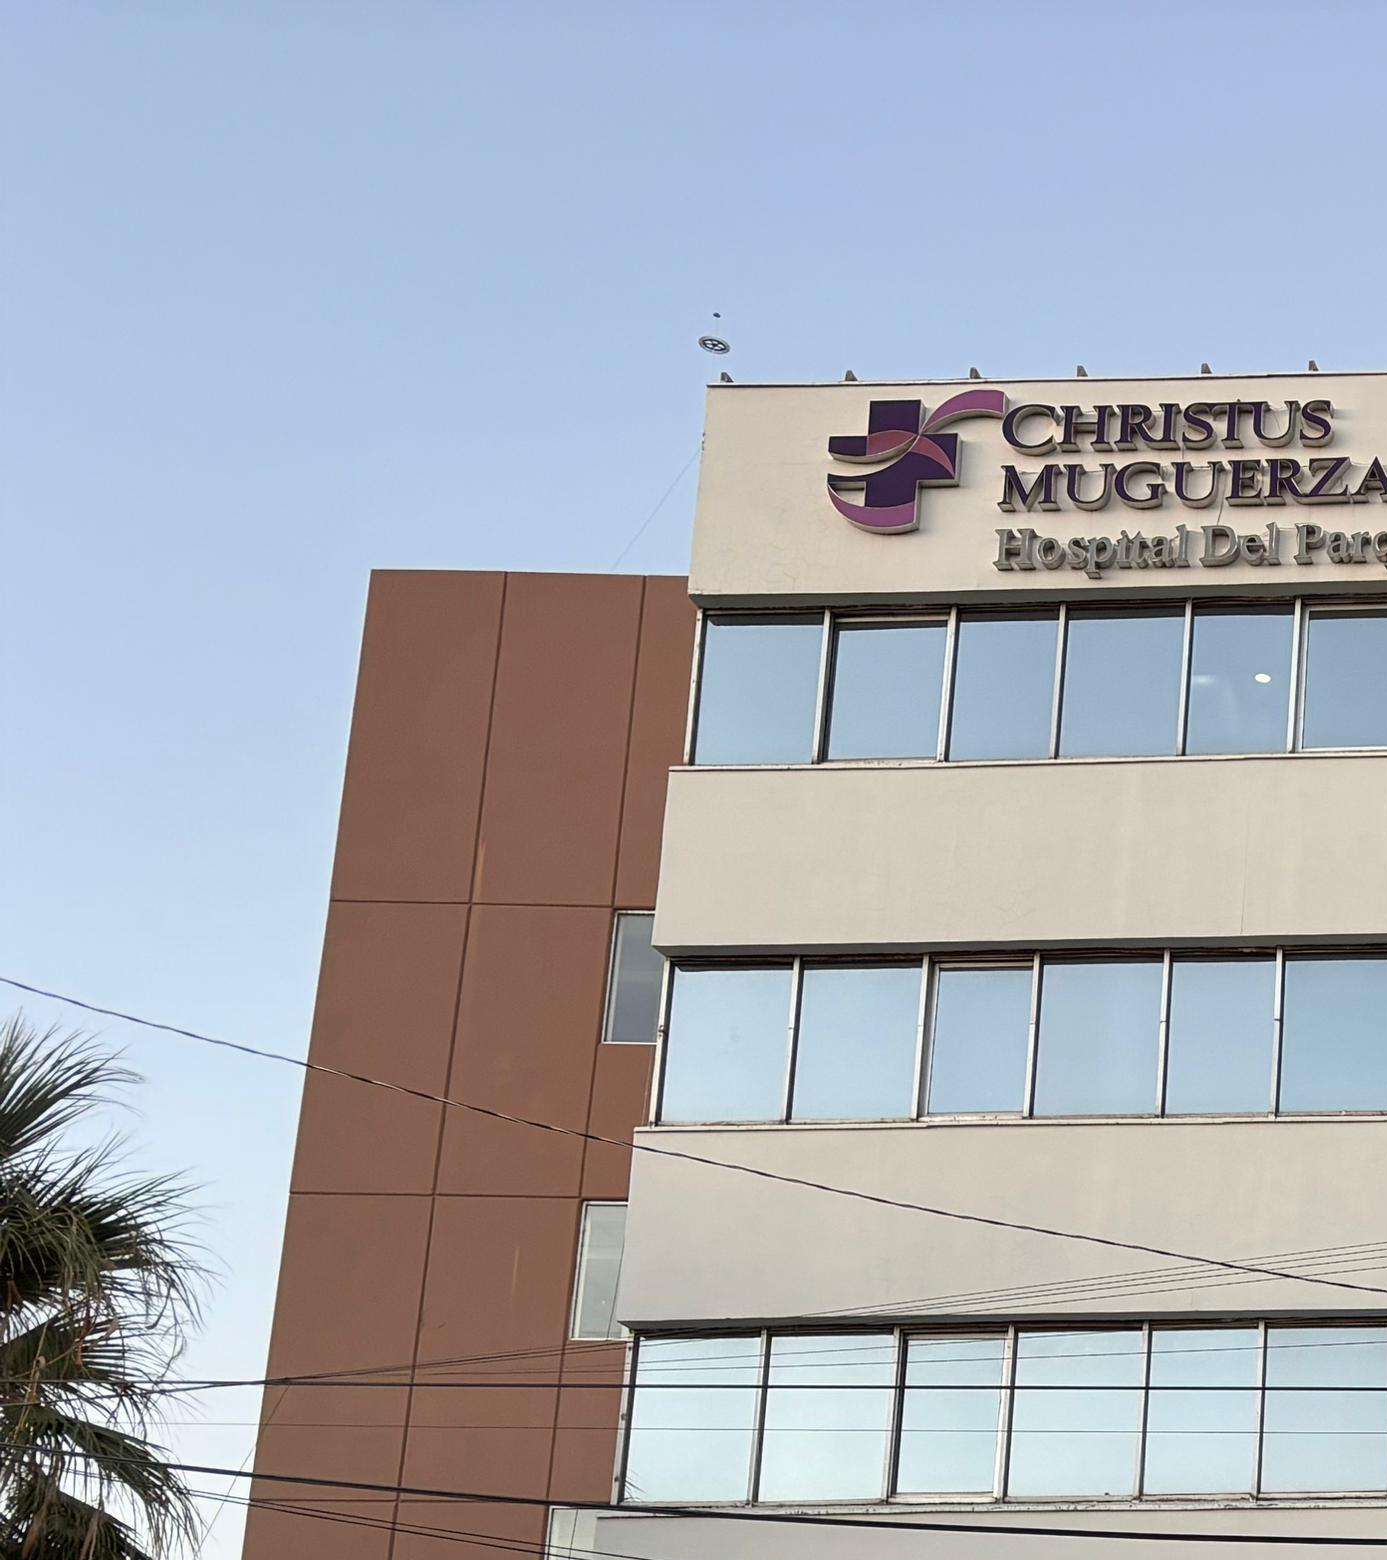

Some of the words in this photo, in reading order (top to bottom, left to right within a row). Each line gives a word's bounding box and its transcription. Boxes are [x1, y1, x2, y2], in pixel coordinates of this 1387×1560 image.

[1001, 399, 1334, 456] CHRISTUS
[993, 523, 1190, 579] Hospital
[1199, 522, 1281, 568] Del
